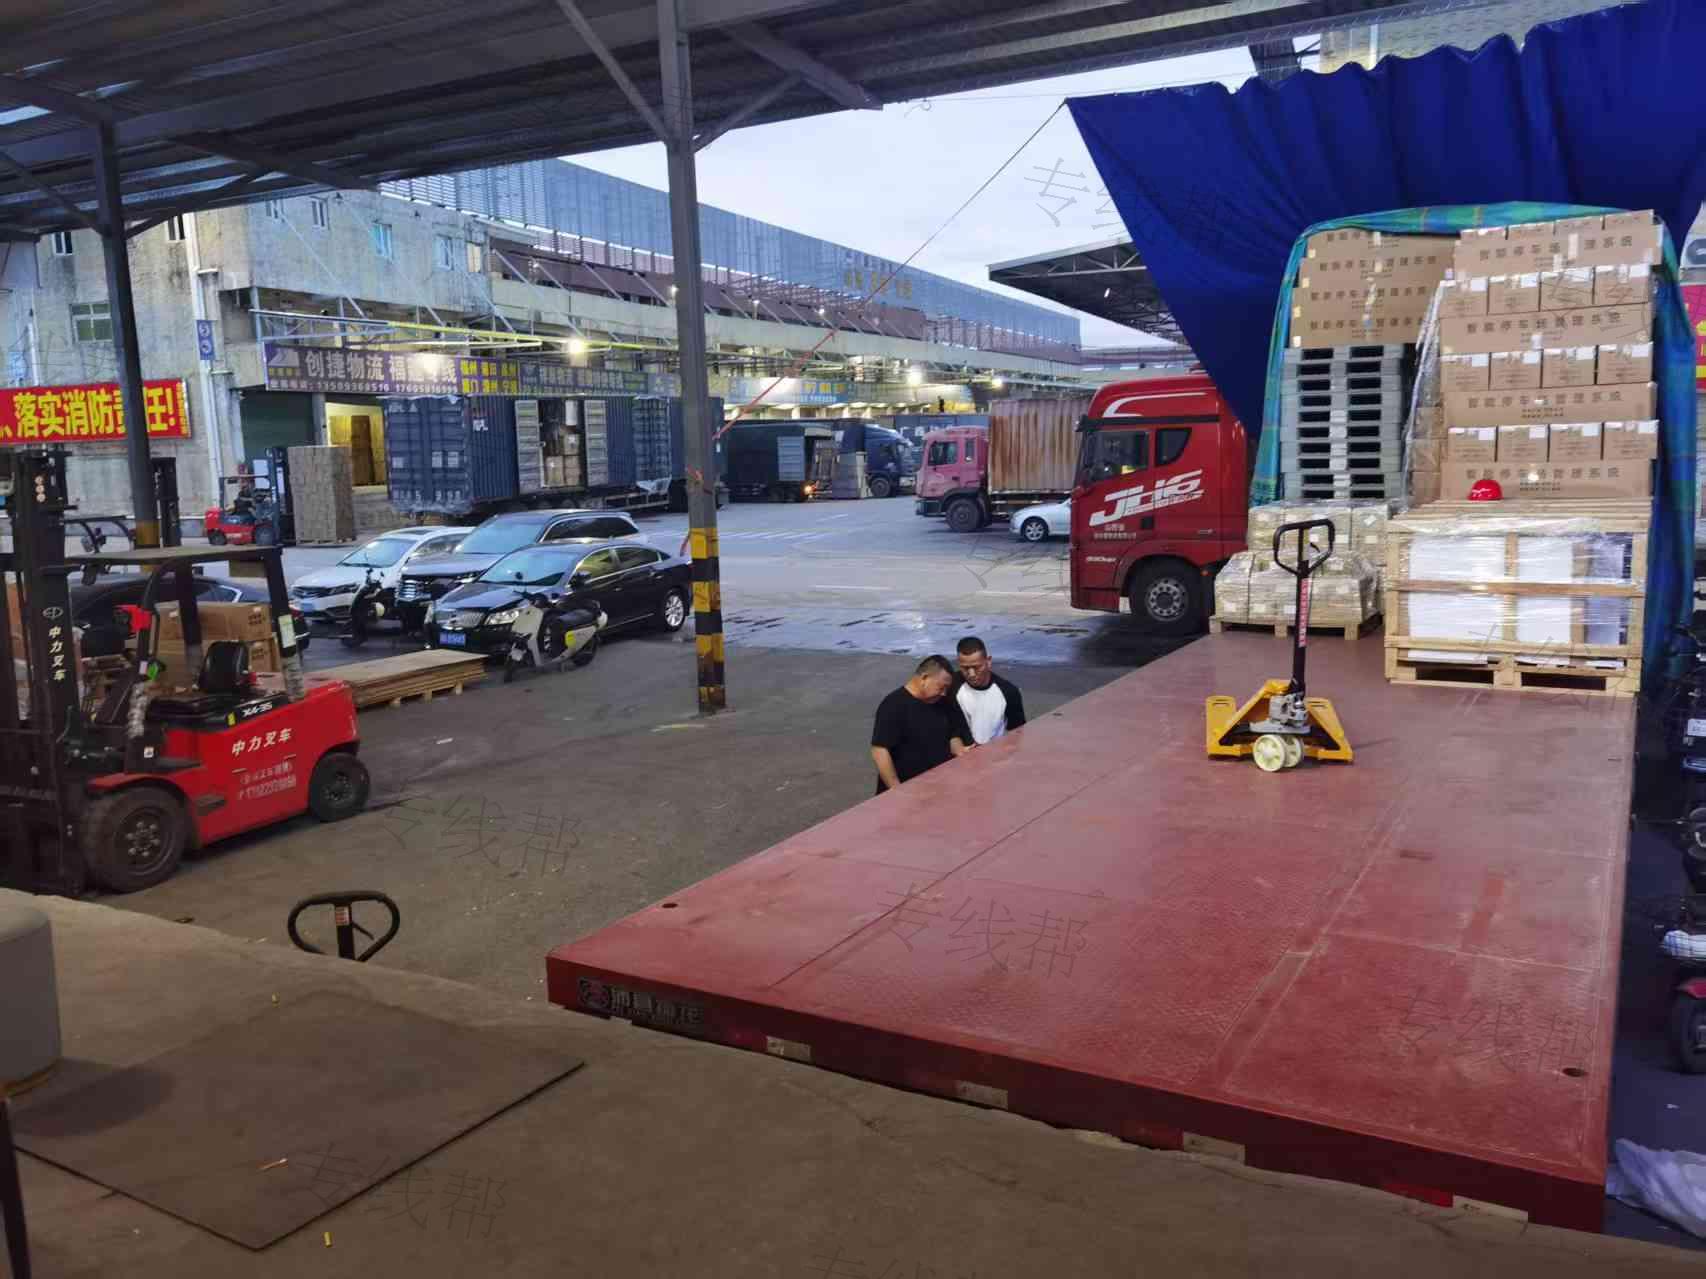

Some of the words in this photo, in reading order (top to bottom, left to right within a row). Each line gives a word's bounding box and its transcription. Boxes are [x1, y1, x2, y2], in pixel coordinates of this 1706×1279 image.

[305, 350, 385, 381] 创捷物流
[48, 625, 67, 681] 中力叉车
[231, 728, 292, 757] 中力叉车
